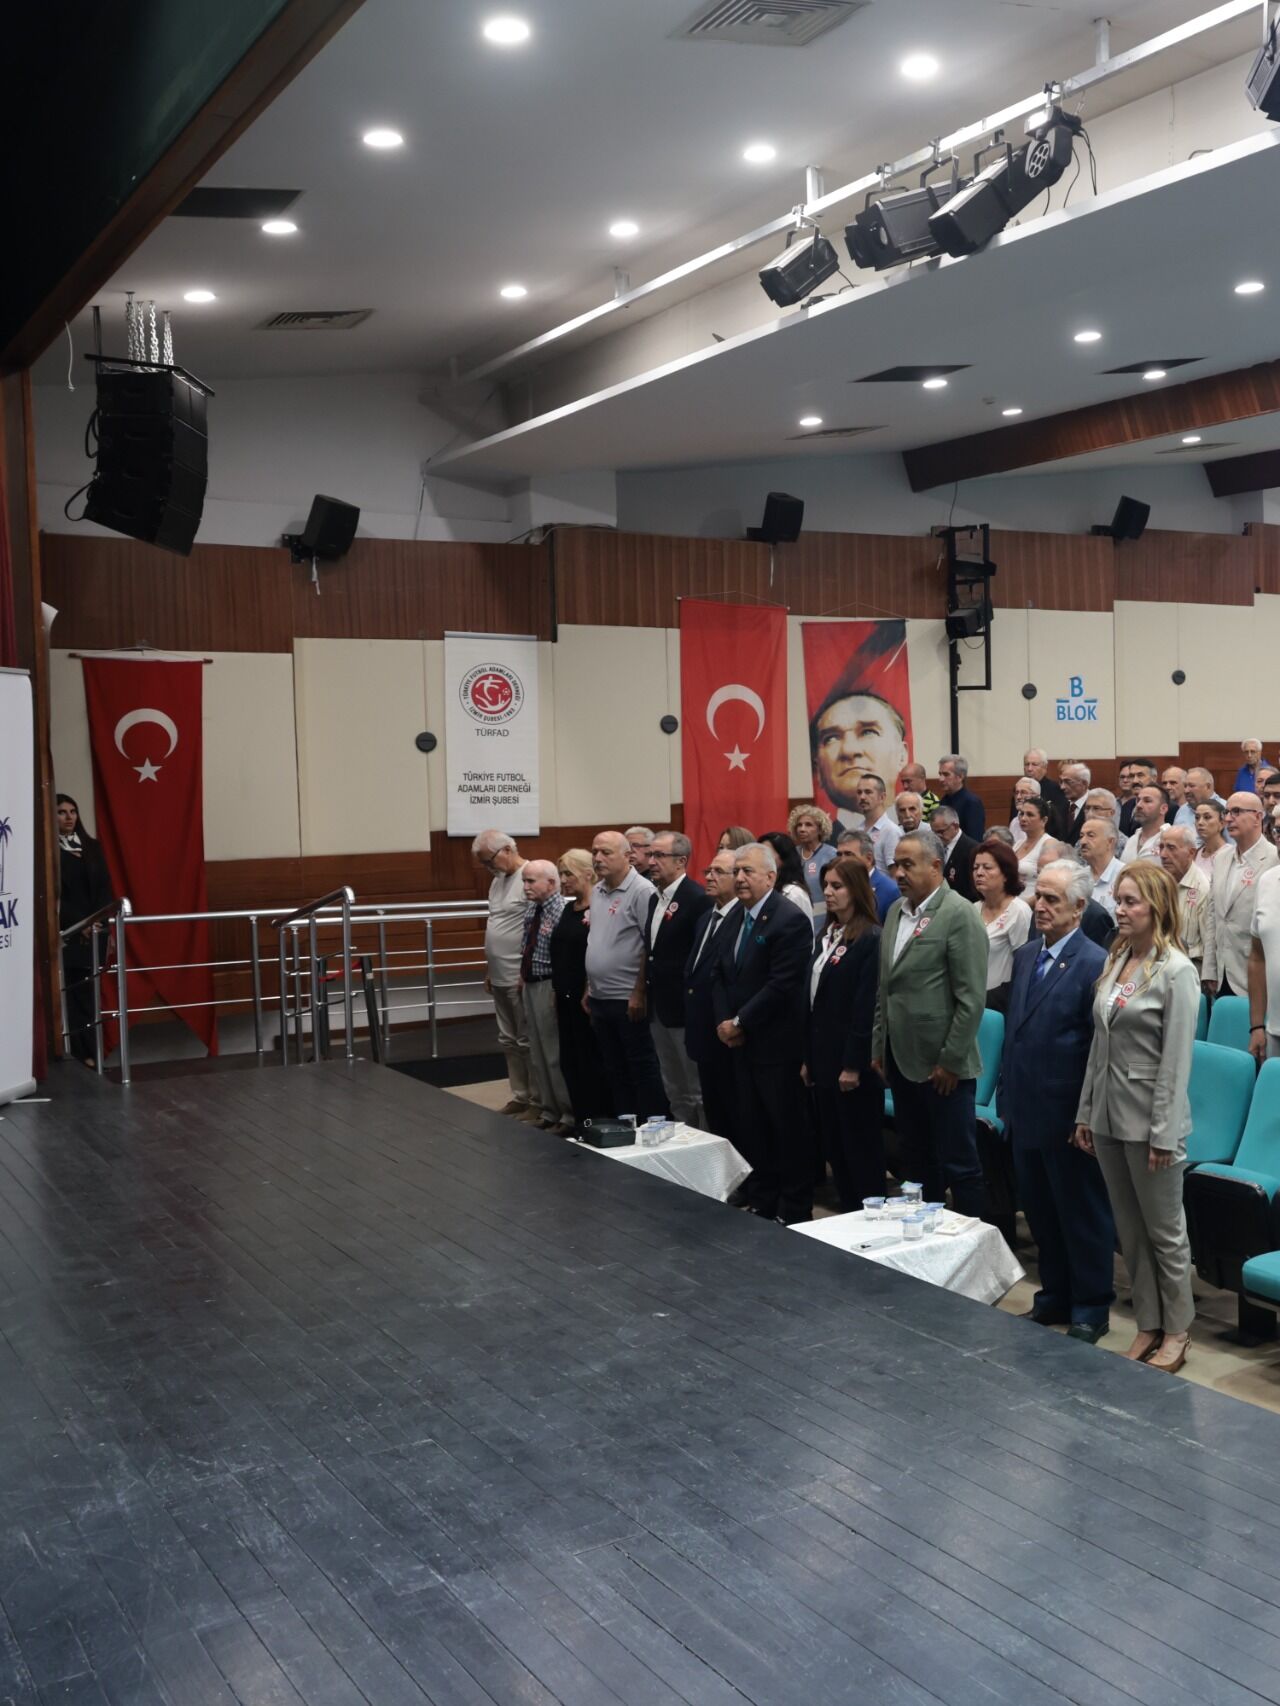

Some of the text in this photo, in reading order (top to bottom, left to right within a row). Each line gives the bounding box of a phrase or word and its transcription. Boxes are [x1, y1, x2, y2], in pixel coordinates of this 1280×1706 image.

[1069, 676, 1084, 698] B
[1056, 704, 1097, 721] BLOK
[475, 728, 510, 737] TÜRFAD
[462, 770, 526, 782] TÜRKİYE FUTBOL
[457, 782, 532, 793] ADAMLARI DERNEĞİ
[469, 794, 519, 806] İZMİR ŞUBESİ
